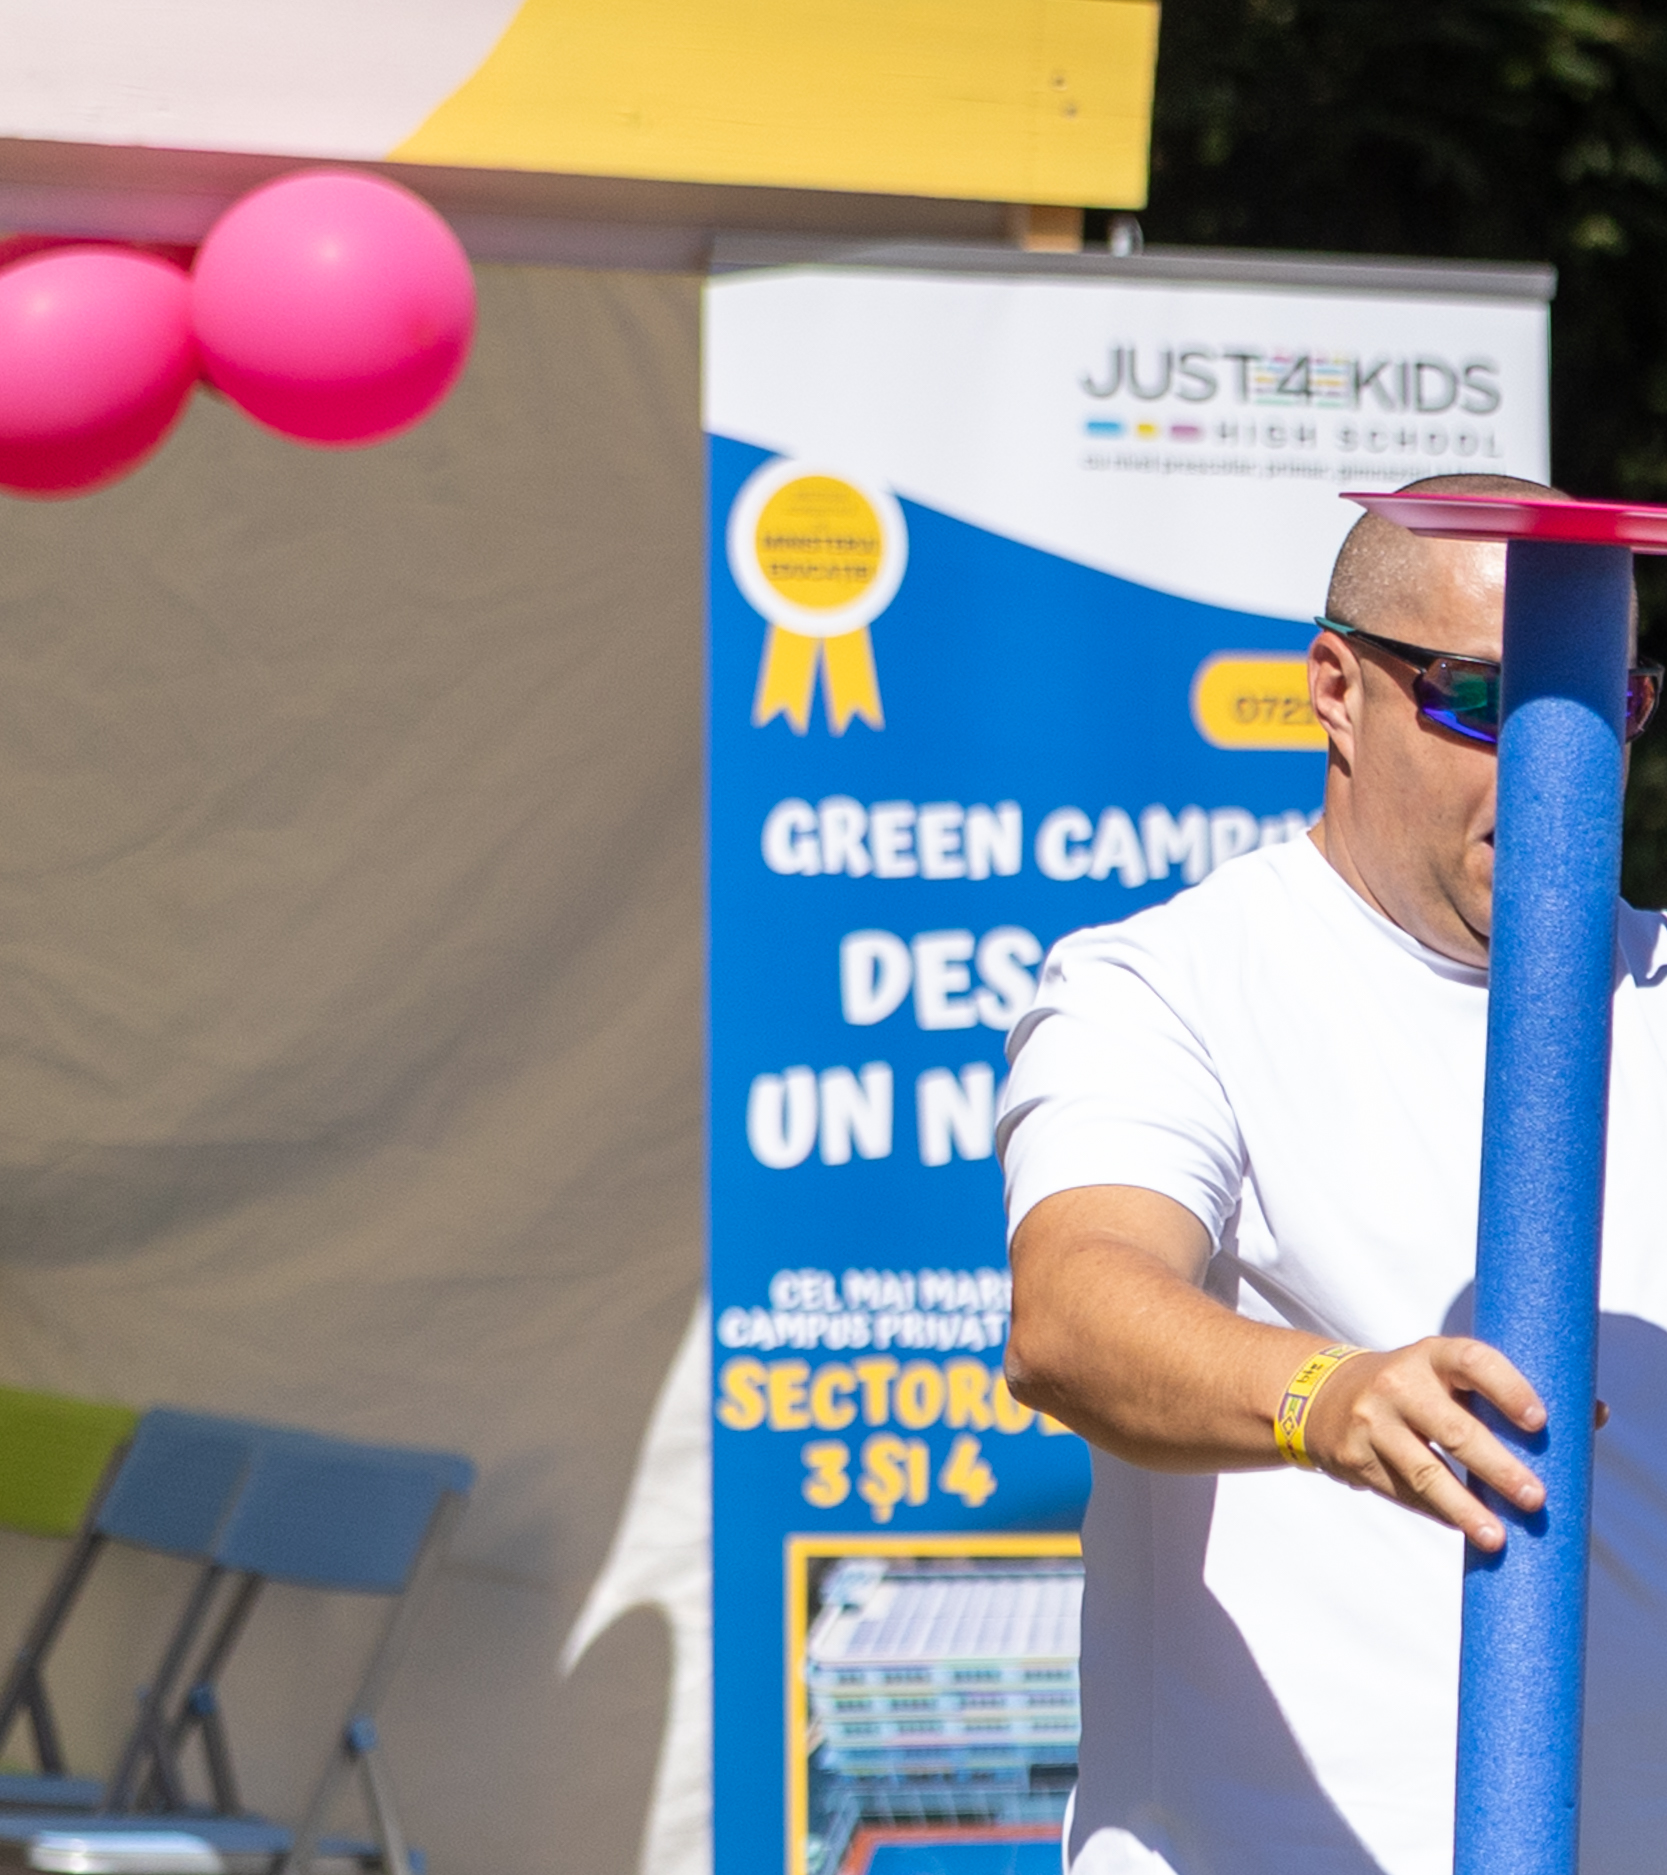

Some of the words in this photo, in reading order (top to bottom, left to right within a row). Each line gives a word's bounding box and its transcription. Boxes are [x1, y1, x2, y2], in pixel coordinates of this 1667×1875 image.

[1081, 344, 1503, 415] JUST4KIDS
[1215, 419, 1319, 448] HIGH
[1335, 425, 1505, 459] SCHOOL
[762, 797, 1022, 881] GREEN
[746, 1060, 894, 1169] UN
[914, 1060, 1006, 1168] N
[768, 1267, 842, 1312] CEL
[842, 1267, 916, 1312] MAI
[717, 1304, 872, 1351] CAMPUS
[872, 1310, 1010, 1352] PRIVAT
[716, 1354, 1076, 1436] SECTOR
[801, 1438, 851, 1509] 3
[938, 1431, 997, 1507] 4
